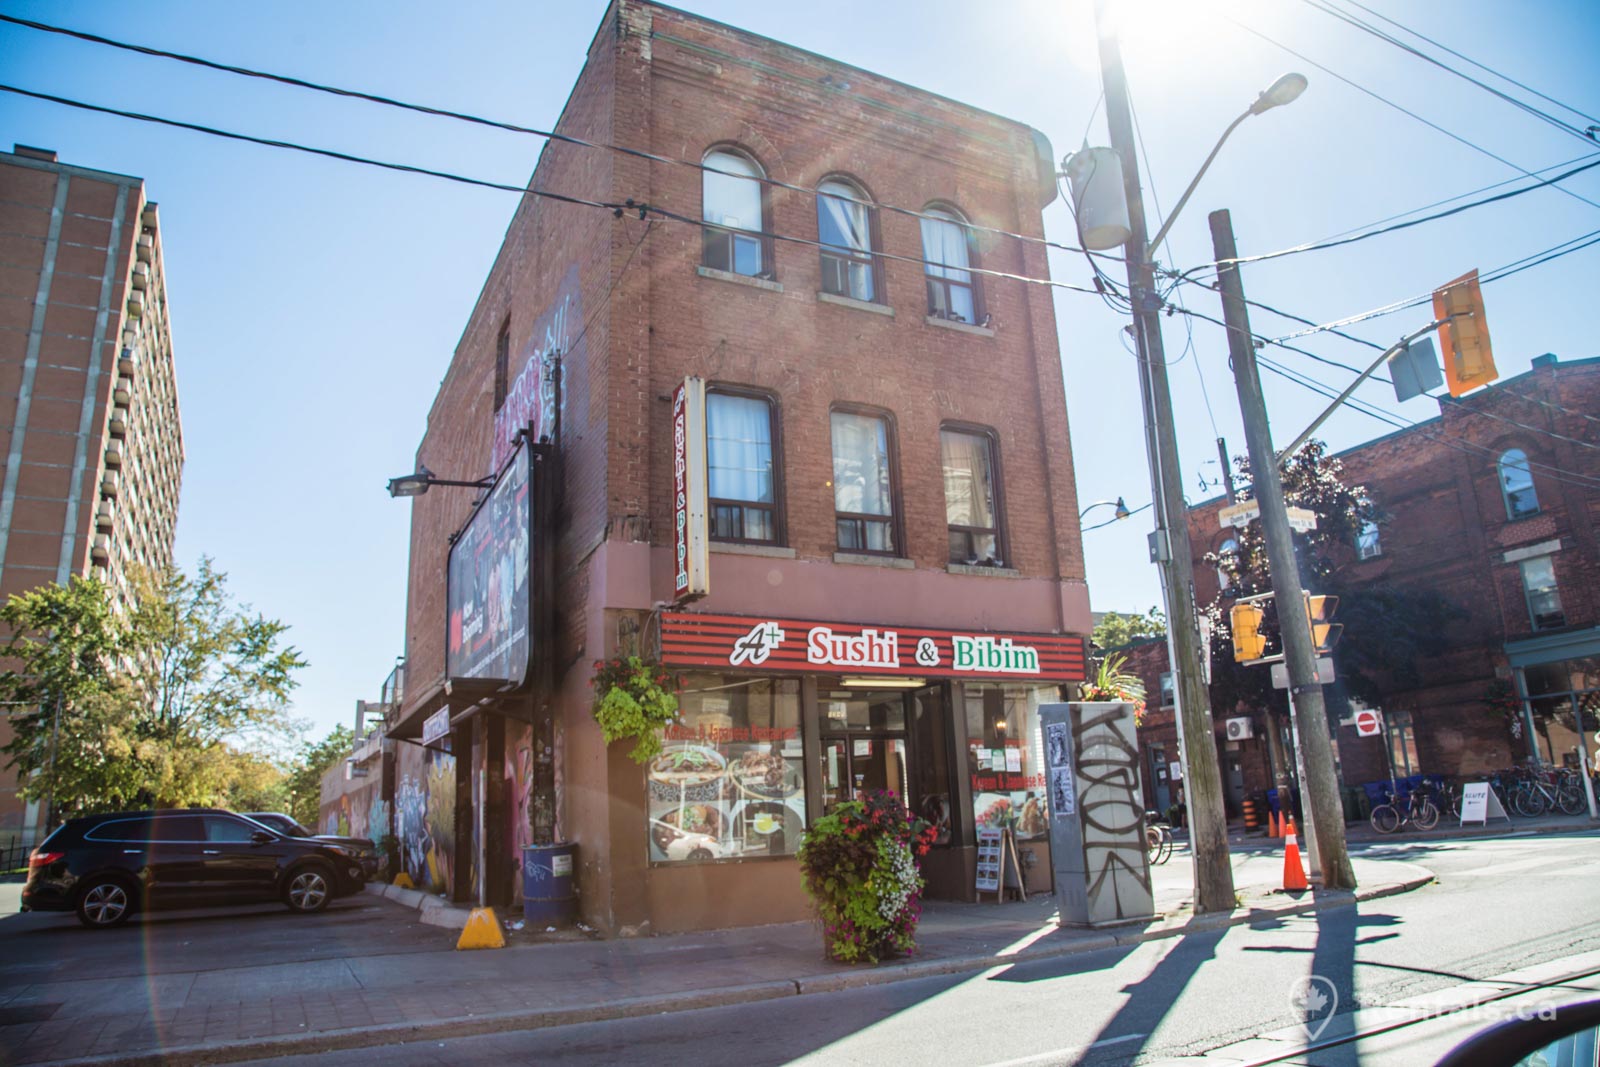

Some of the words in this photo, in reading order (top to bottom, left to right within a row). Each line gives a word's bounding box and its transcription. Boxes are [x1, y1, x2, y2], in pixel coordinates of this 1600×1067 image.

[674, 414, 686, 491] Sushi
[676, 491, 686, 509] &
[676, 509, 688, 591] Bibim
[731, 624, 783, 663] A+
[810, 629, 898, 667] Sushi
[917, 640, 938, 664] &
[954, 638, 1039, 671] Bibim
[709, 722, 749, 741] Japanese
[971, 774, 997, 790] Korean
[998, 772, 1004, 790] &
[1005, 774, 1036, 790] Japanese
